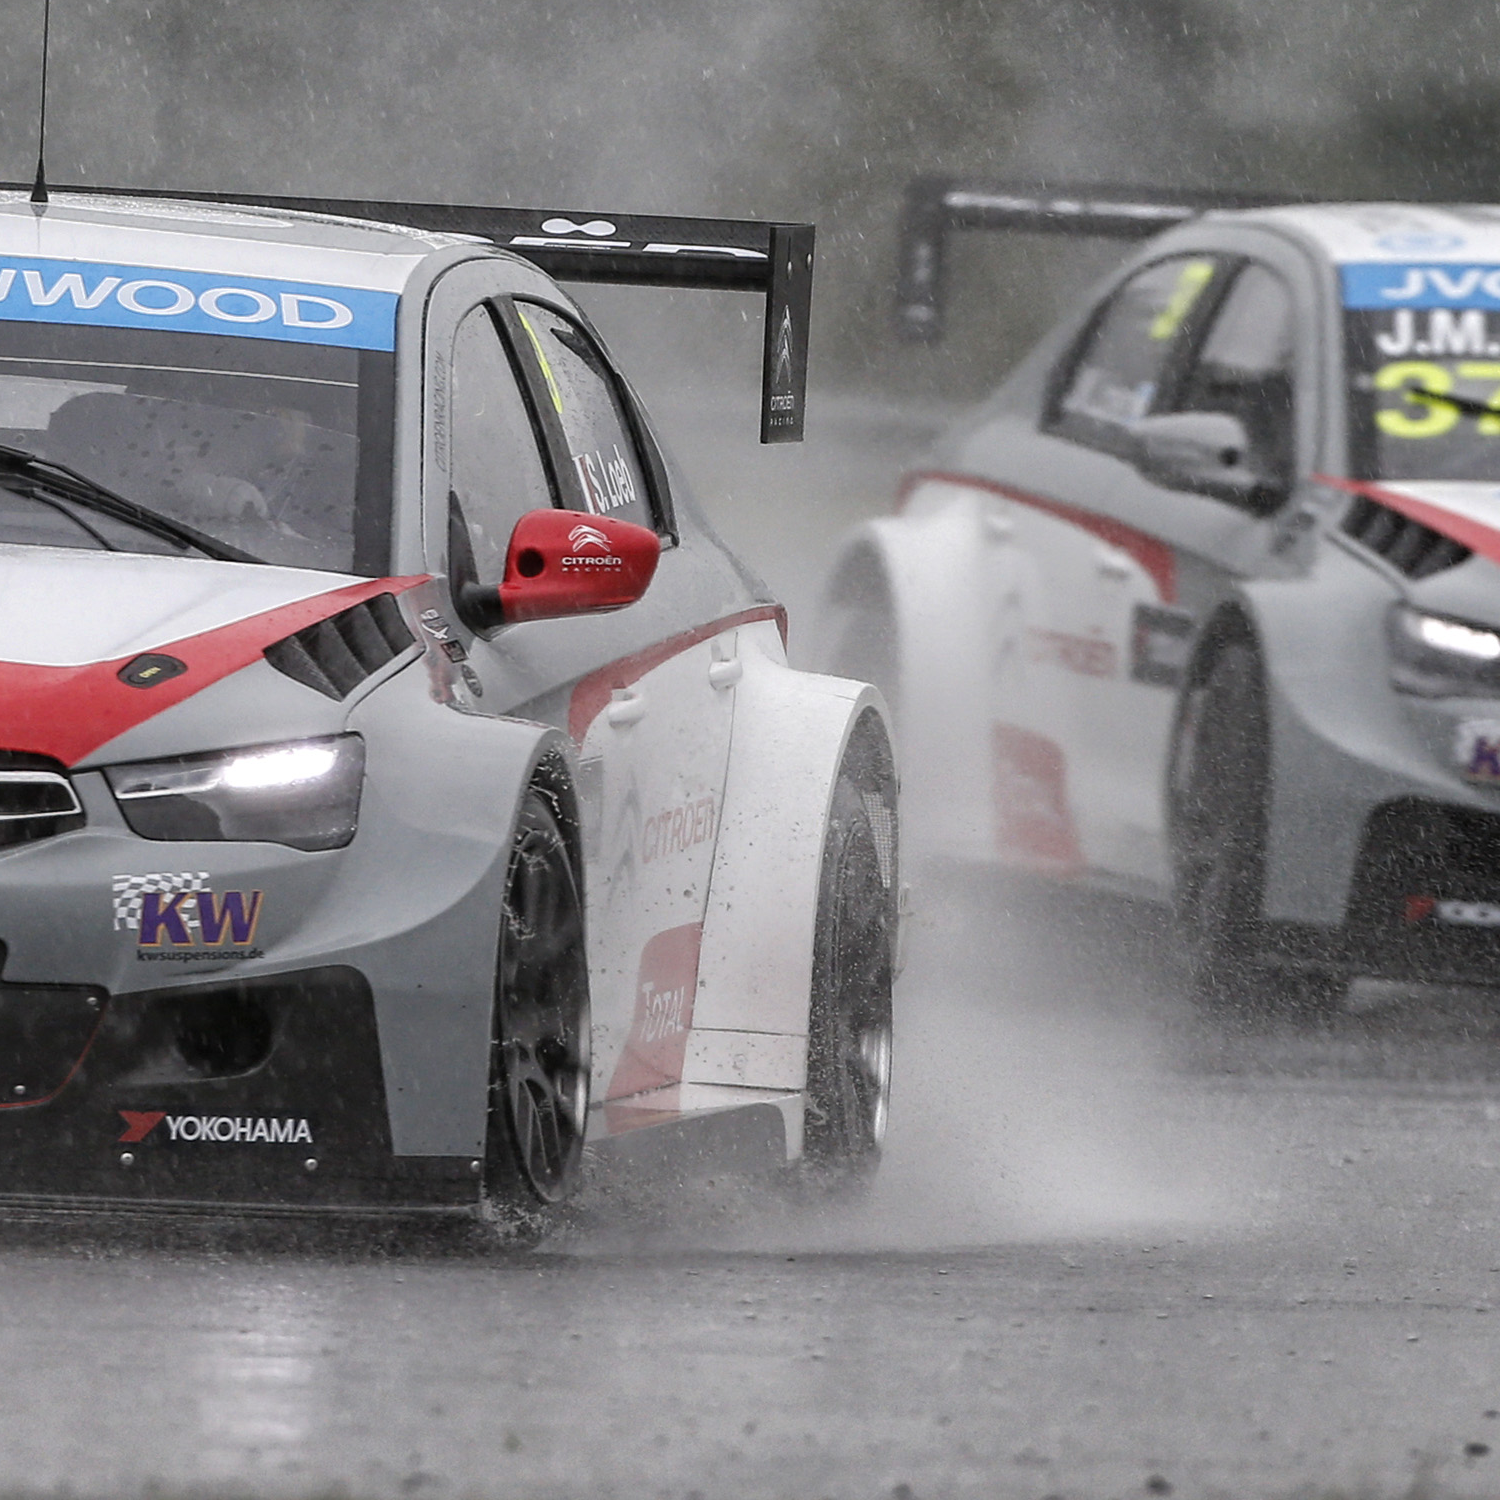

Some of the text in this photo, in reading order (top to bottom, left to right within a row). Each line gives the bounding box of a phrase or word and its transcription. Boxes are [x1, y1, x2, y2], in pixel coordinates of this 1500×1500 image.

[138, 888, 264, 946] KW
[137, 949, 266, 963] kwsuspensions.de
[165, 1115, 313, 1143] YOKOHAMA
